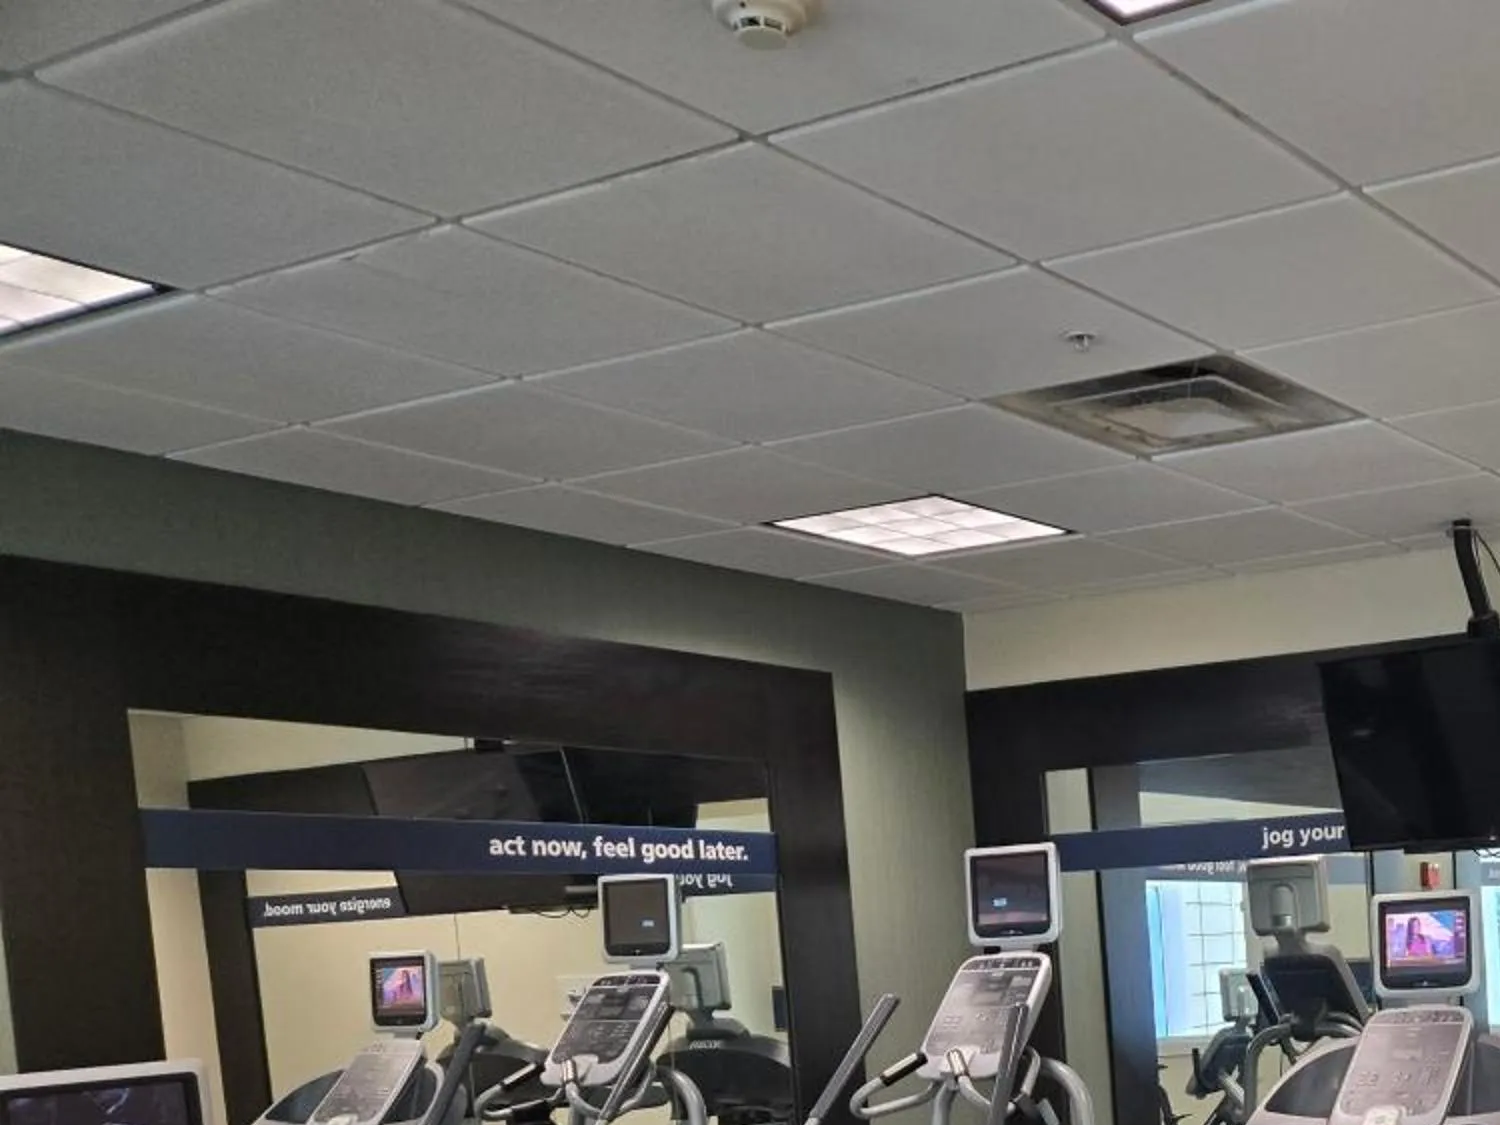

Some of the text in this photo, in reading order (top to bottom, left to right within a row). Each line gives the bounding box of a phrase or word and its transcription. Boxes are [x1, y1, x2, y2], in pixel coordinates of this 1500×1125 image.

[489, 836, 749, 864] act now, feel good later.
[1262, 825, 1345, 850] jog your
